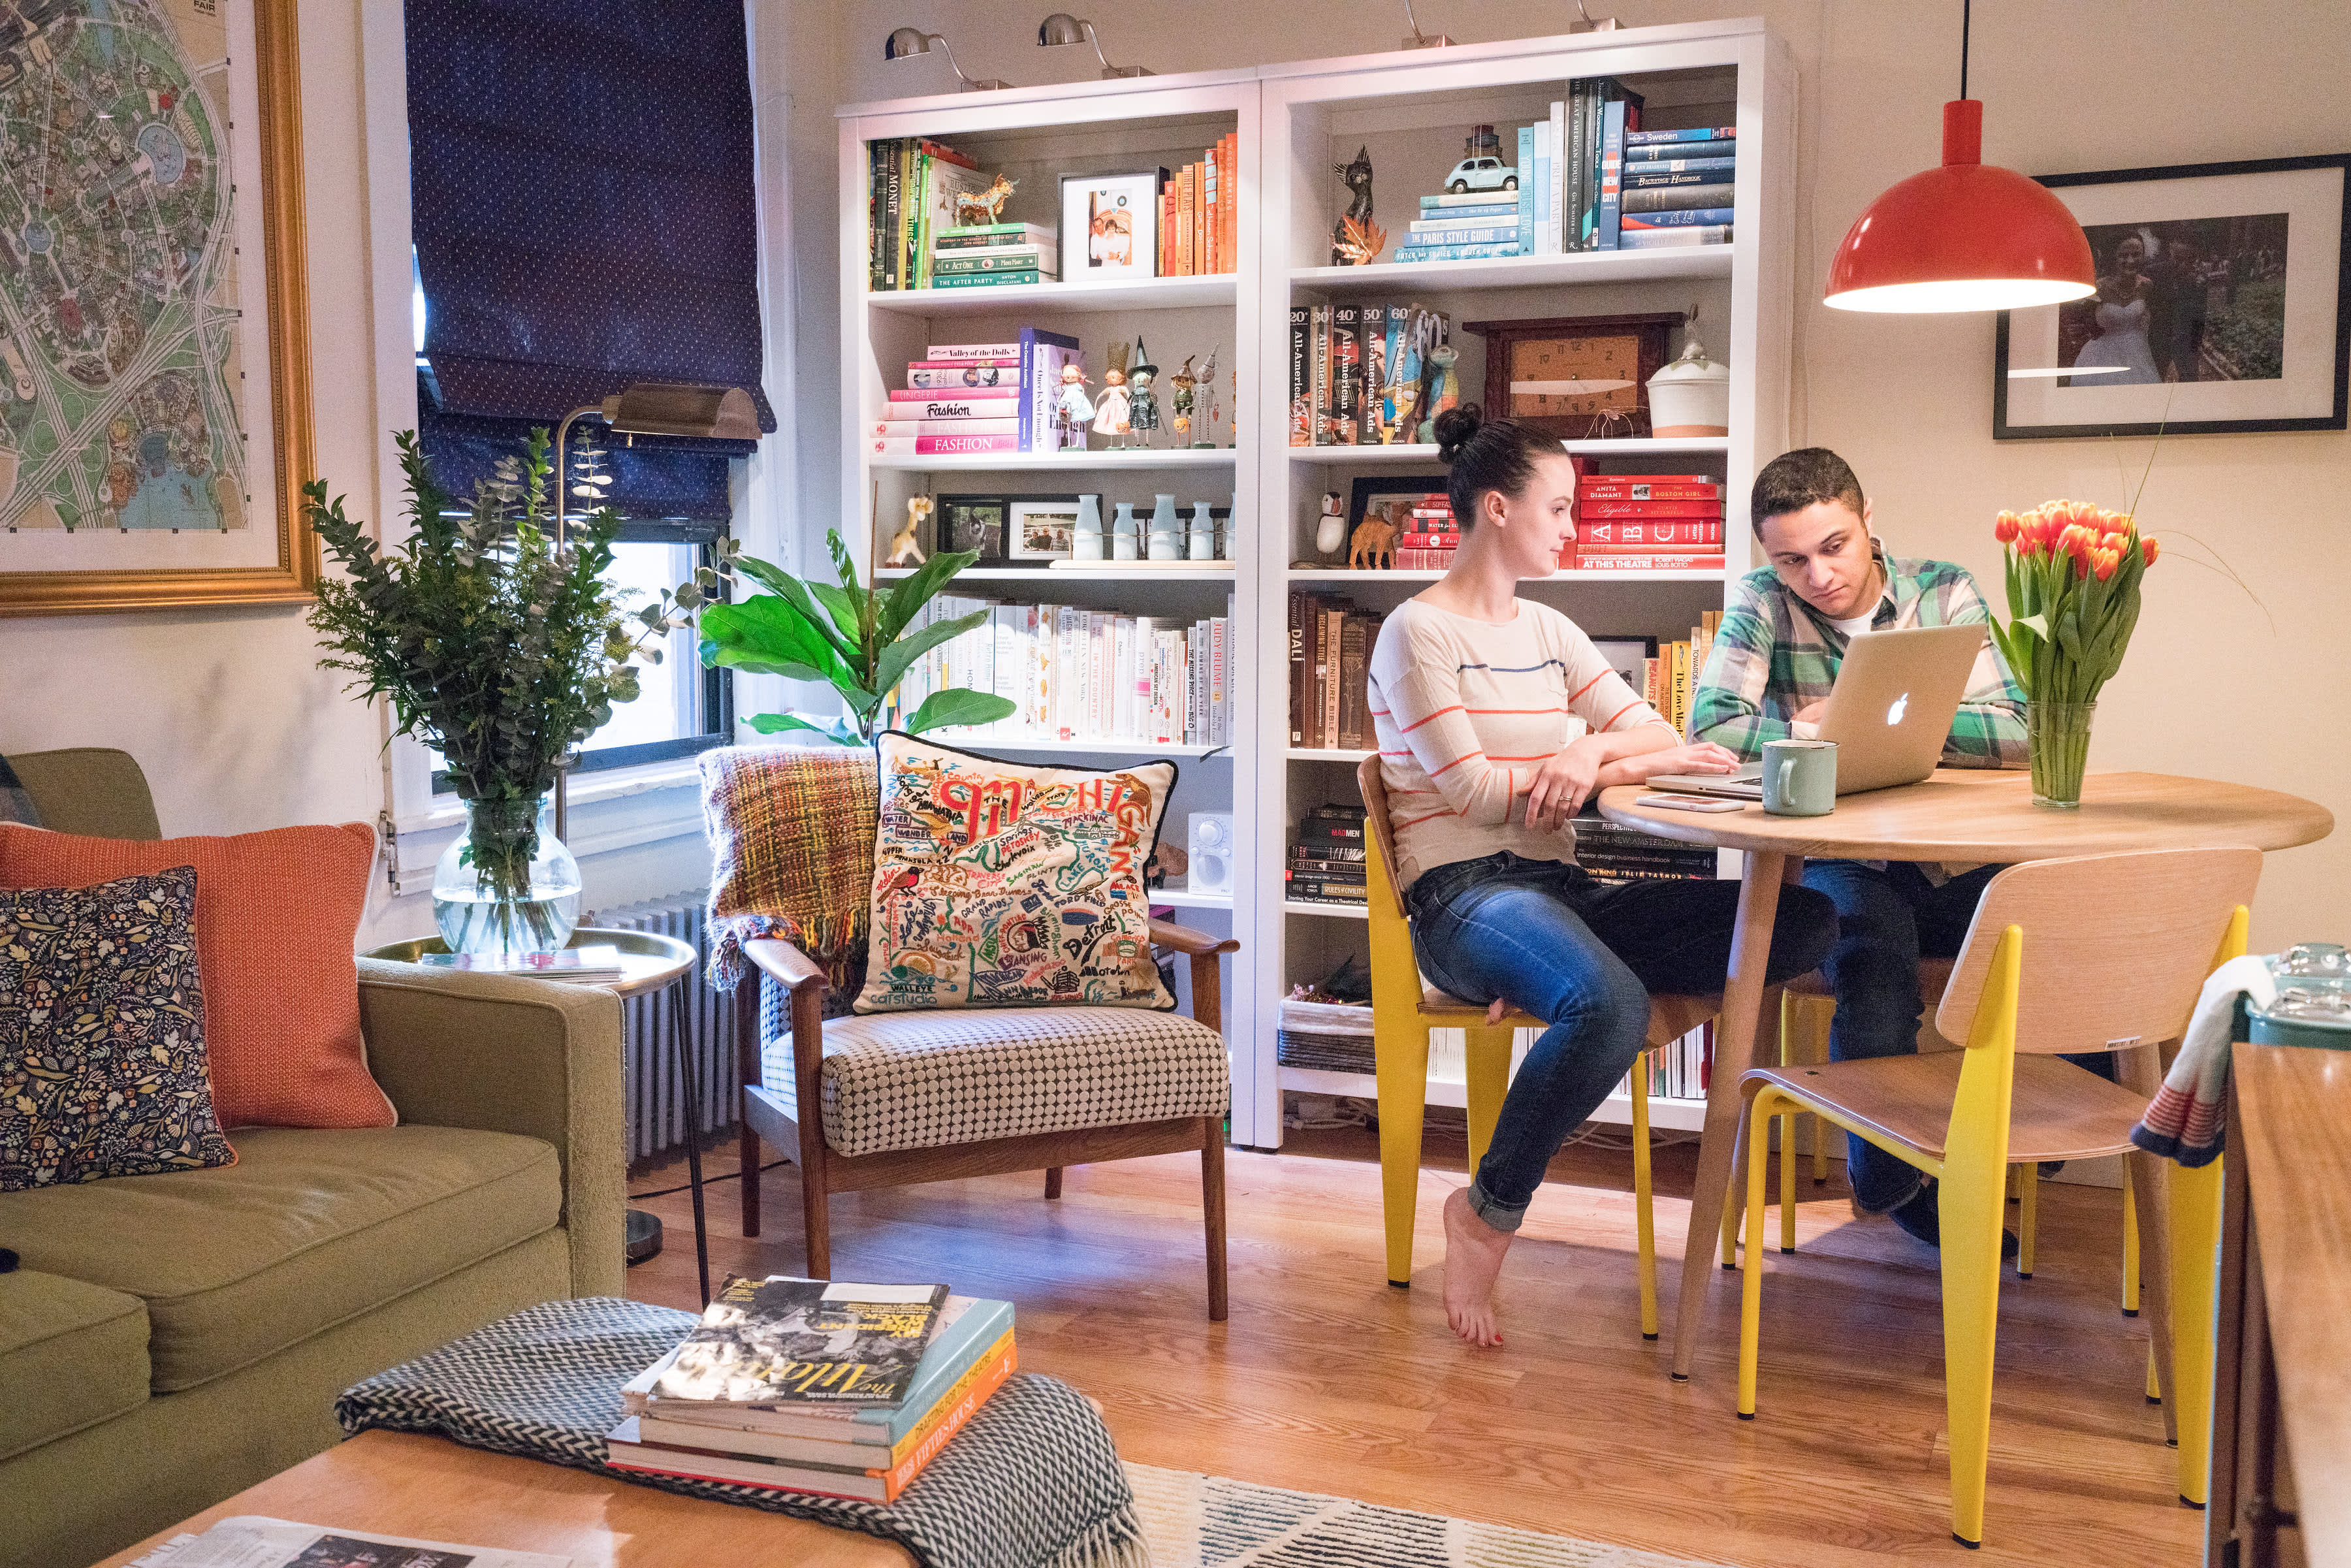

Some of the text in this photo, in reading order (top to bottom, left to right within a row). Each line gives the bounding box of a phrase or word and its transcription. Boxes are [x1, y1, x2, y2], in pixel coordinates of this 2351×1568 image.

[194, 0, 216, 12] FAIR
[1646, 133, 1678, 142] Sweden
[1602, 159, 1622, 170] GUIDE
[1603, 176, 1618, 185] NEW
[1638, 175, 1702, 186] BACKSTAGE HANDBOOK
[888, 175, 899, 215] MONET
[1183, 168, 1193, 212] THREE PLAYS
[1520, 154, 1531, 236] YOUNG HOUSE LOVE
[1602, 193, 1618, 202] CITY
[1422, 232, 1444, 244] PARIS
[1447, 231, 1469, 244] STYLE
[1471, 229, 1494, 242] GUIDE
[950, 349, 968, 358] Valley
[1294, 330, 1303, 432] All-American Ads
[1317, 334, 1328, 434] All-American Ads
[1341, 331, 1352, 436] All-American Ads
[1367, 331, 1378, 434] All-American Ads
[1394, 330, 1406, 433] All-American Ads
[900, 390, 938, 400] LINGERIE
[927, 403, 971, 418] Fashion
[935, 438, 993, 451] FASHION
[1598, 504, 1632, 518] Eligible
[1593, 524, 1612, 542] A
[1623, 526, 1642, 541] B
[1655, 525, 1674, 541] C
[1290, 594, 1304, 662] Essential DALÍ
[1318, 615, 1326, 644] RECLAIMING
[1213, 622, 1222, 687] JUDY BLUME
[1648, 660, 1657, 701] PEANUTS
[1676, 671, 1685, 711] The Love
[947, 772, 986, 785] Country
[1046, 792, 1066, 801] STATE
[885, 814, 908, 824] WATER
[1062, 813, 1109, 830] MACKINAC
[897, 828, 932, 839] WONDER
[947, 832, 967, 843] LAND
[999, 826, 1034, 847] Springs
[1593, 835, 1684, 848] THE AMSTERDAM
[1000, 831, 1040, 857] PETOSKEY
[1061, 840, 1110, 888] LAKE HURON
[1597, 853, 1616, 861] design
[1641, 855, 1671, 863] handbook
[967, 869, 1006, 880] TRAVERSE
[1006, 859, 1045, 887] SAGINAW
[1026, 866, 1057, 882] FLINT
[977, 880, 1002, 889] CITY
[929, 886, 972, 904] Sleeping
[961, 898, 987, 918] GRAND
[979, 897, 1008, 919] RAPIDS
[953, 915, 974, 935] ADA
[936, 933, 980, 943] Holland
[1062, 914, 1117, 961] Detroit
[1116, 957, 1137, 965] PARK
[870, 993, 937, 1005] catstudio
[948, 1393, 976, 1432] HOUSE
